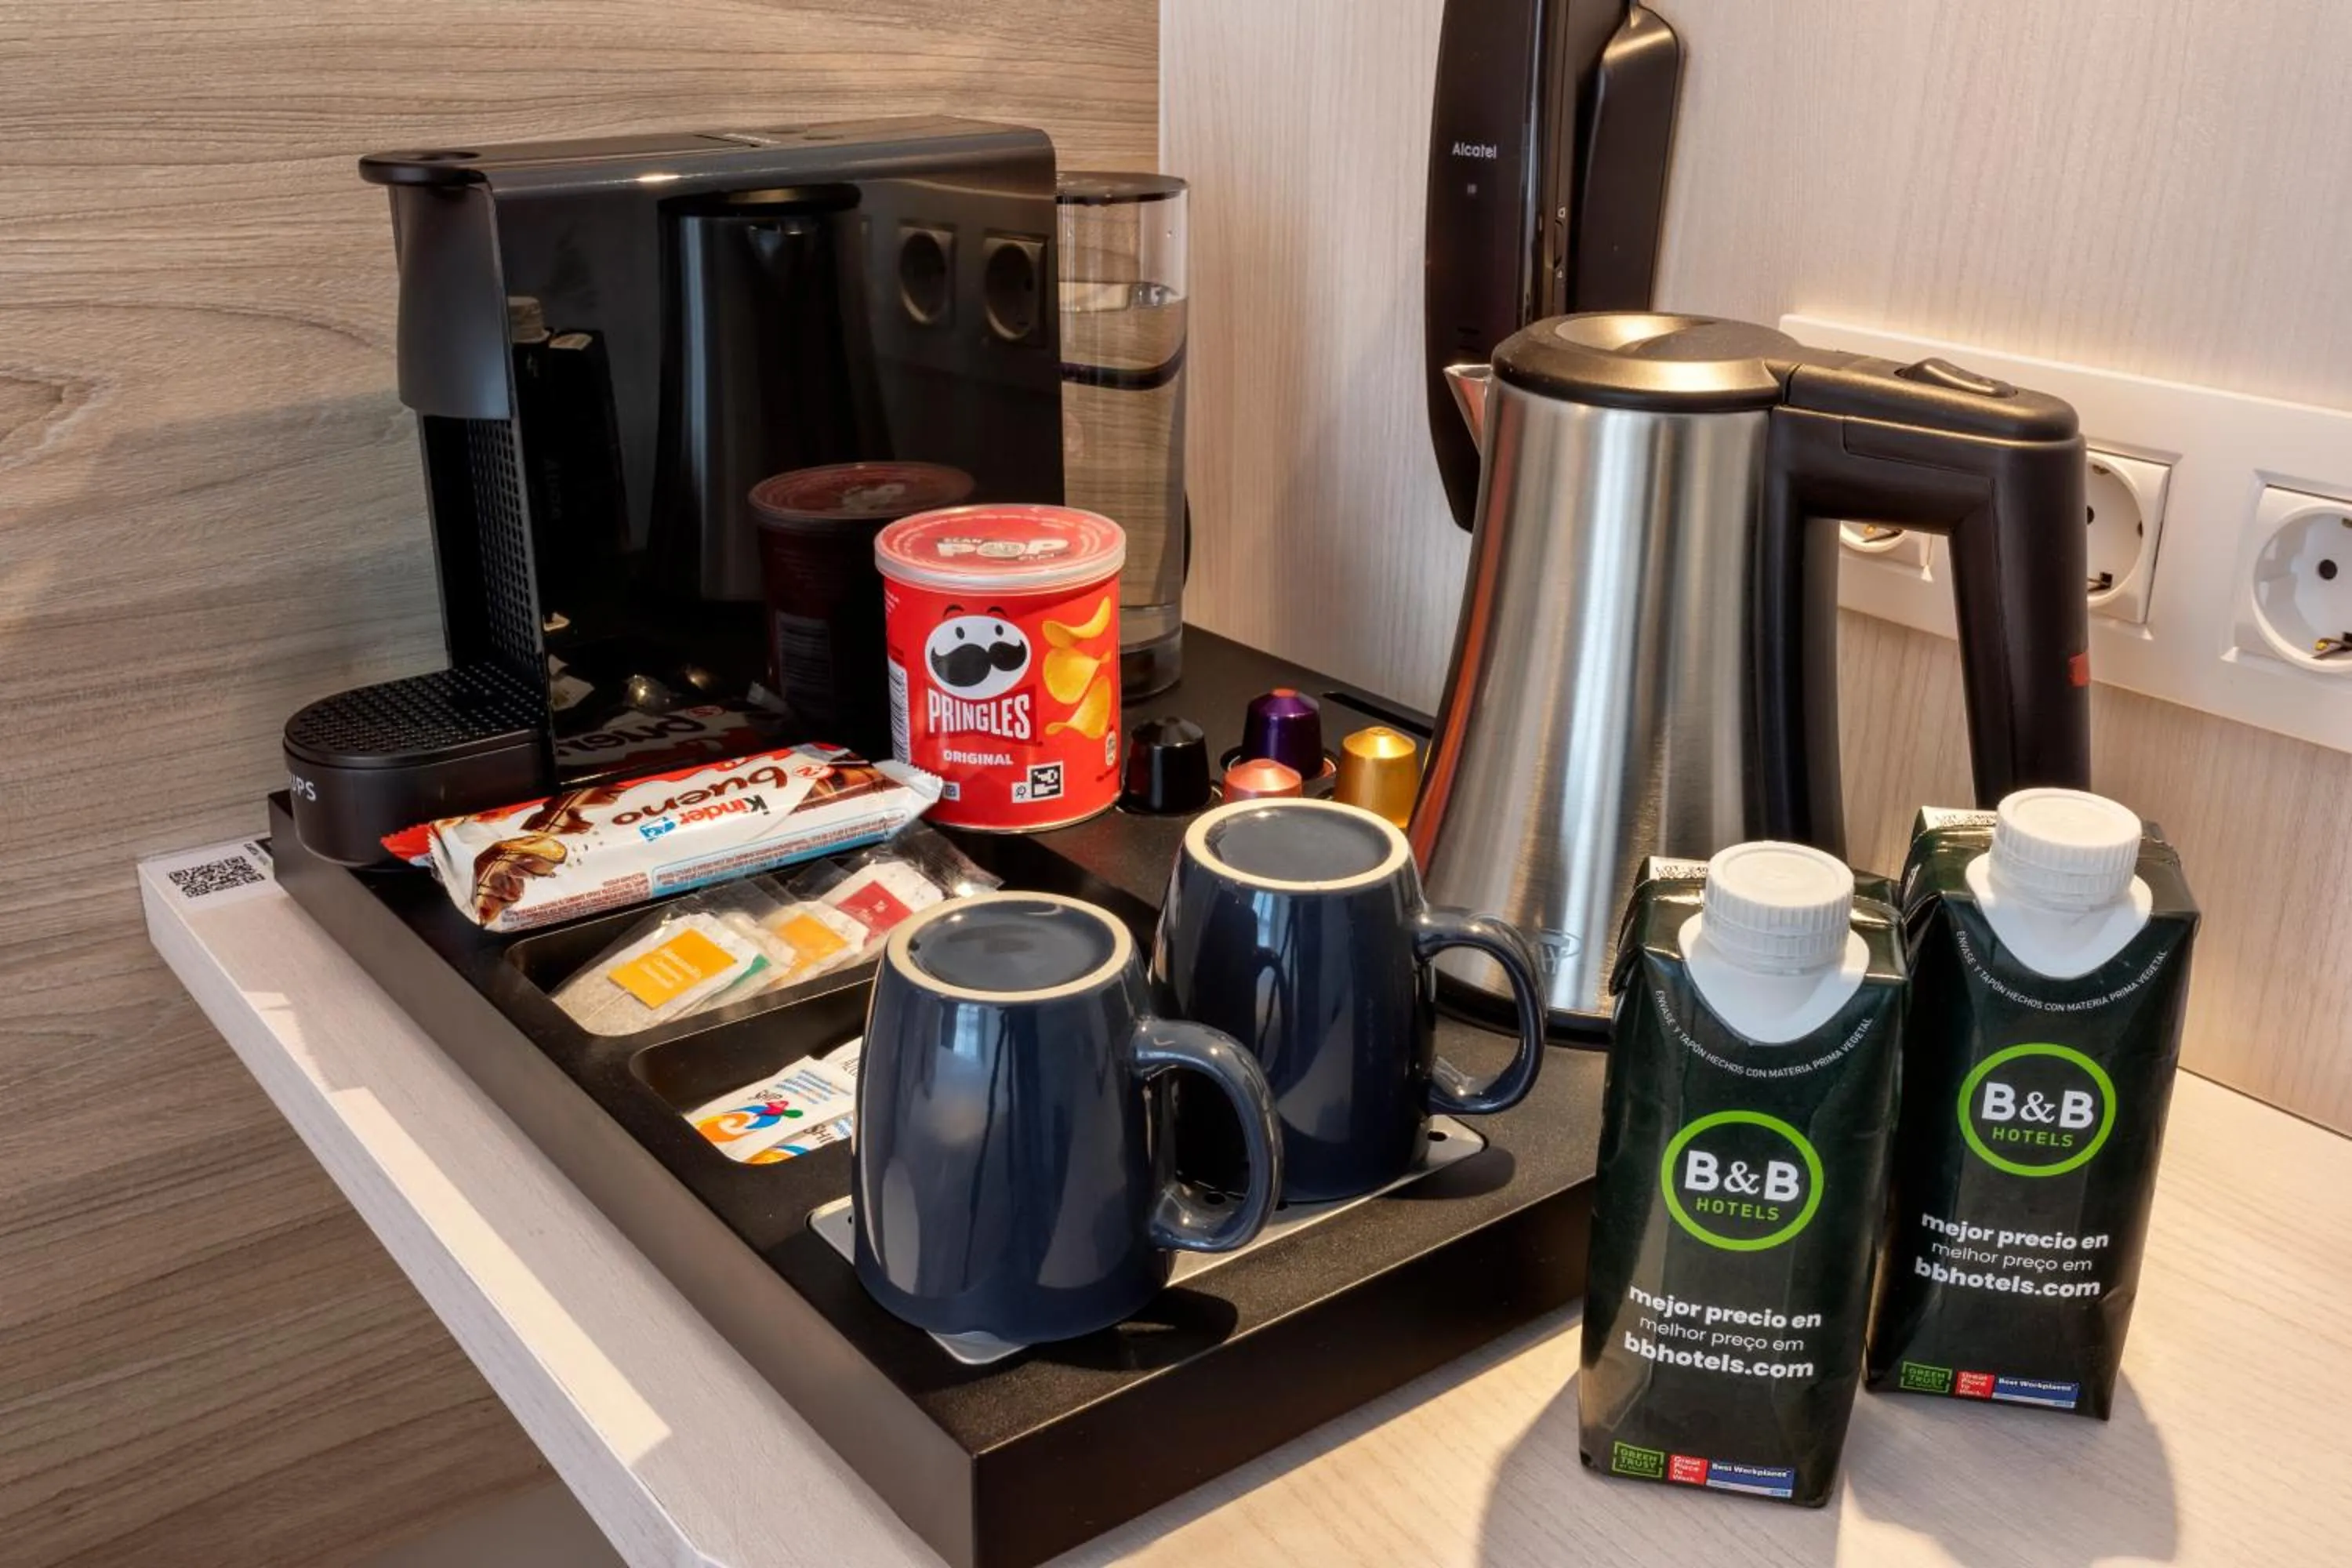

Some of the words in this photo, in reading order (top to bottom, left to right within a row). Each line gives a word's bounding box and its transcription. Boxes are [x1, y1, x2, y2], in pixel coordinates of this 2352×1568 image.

[1453, 142, 1497, 158] Alcatel
[927, 688, 1031, 740] PRINGLES
[943, 748, 1014, 766] ORIGINAL
[612, 765, 788, 826] bueno
[2005, 989, 2042, 1009] HECHOS
[2043, 1002, 2065, 1012] CON
[2067, 997, 2109, 1011] MATERIA
[2110, 982, 2140, 1000] PRIMA
[2138, 949, 2169, 985] VEGETAL
[1655, 989, 1675, 1026] ENVASE
[1706, 1054, 1744, 1076] HECHOS
[1746, 1066, 1767, 1078] CON
[1769, 1063, 1813, 1078] MATERIA
[1813, 1050, 1844, 1070] PRIMA
[1843, 1018, 1874, 1053] VEGETAL
[1981, 1081, 2095, 1129] B&B
[1992, 1126, 2074, 1148] HOTELS
[1684, 1149, 1799, 1203] B&B
[1696, 1197, 1780, 1221] HOTELS
[1922, 1212, 1994, 1245] mejor
[1998, 1231, 2077, 1250] precio
[2082, 1233, 2110, 1249] en
[1915, 1257, 2101, 1298] bbhotels.com
[1931, 1240, 1998, 1265] melhor
[2002, 1253, 2058, 1272] preço
[2062, 1258, 2092, 1272] em
[1628, 1284, 1701, 1319] mejor
[1704, 1305, 1787, 1329] precio
[1791, 1311, 1822, 1328] en
[1624, 1331, 1814, 1378] bbhotels.com
[1639, 1315, 1706, 1341] melhor
[1711, 1331, 1767, 1352] preço
[1773, 1338, 1804, 1351] em
